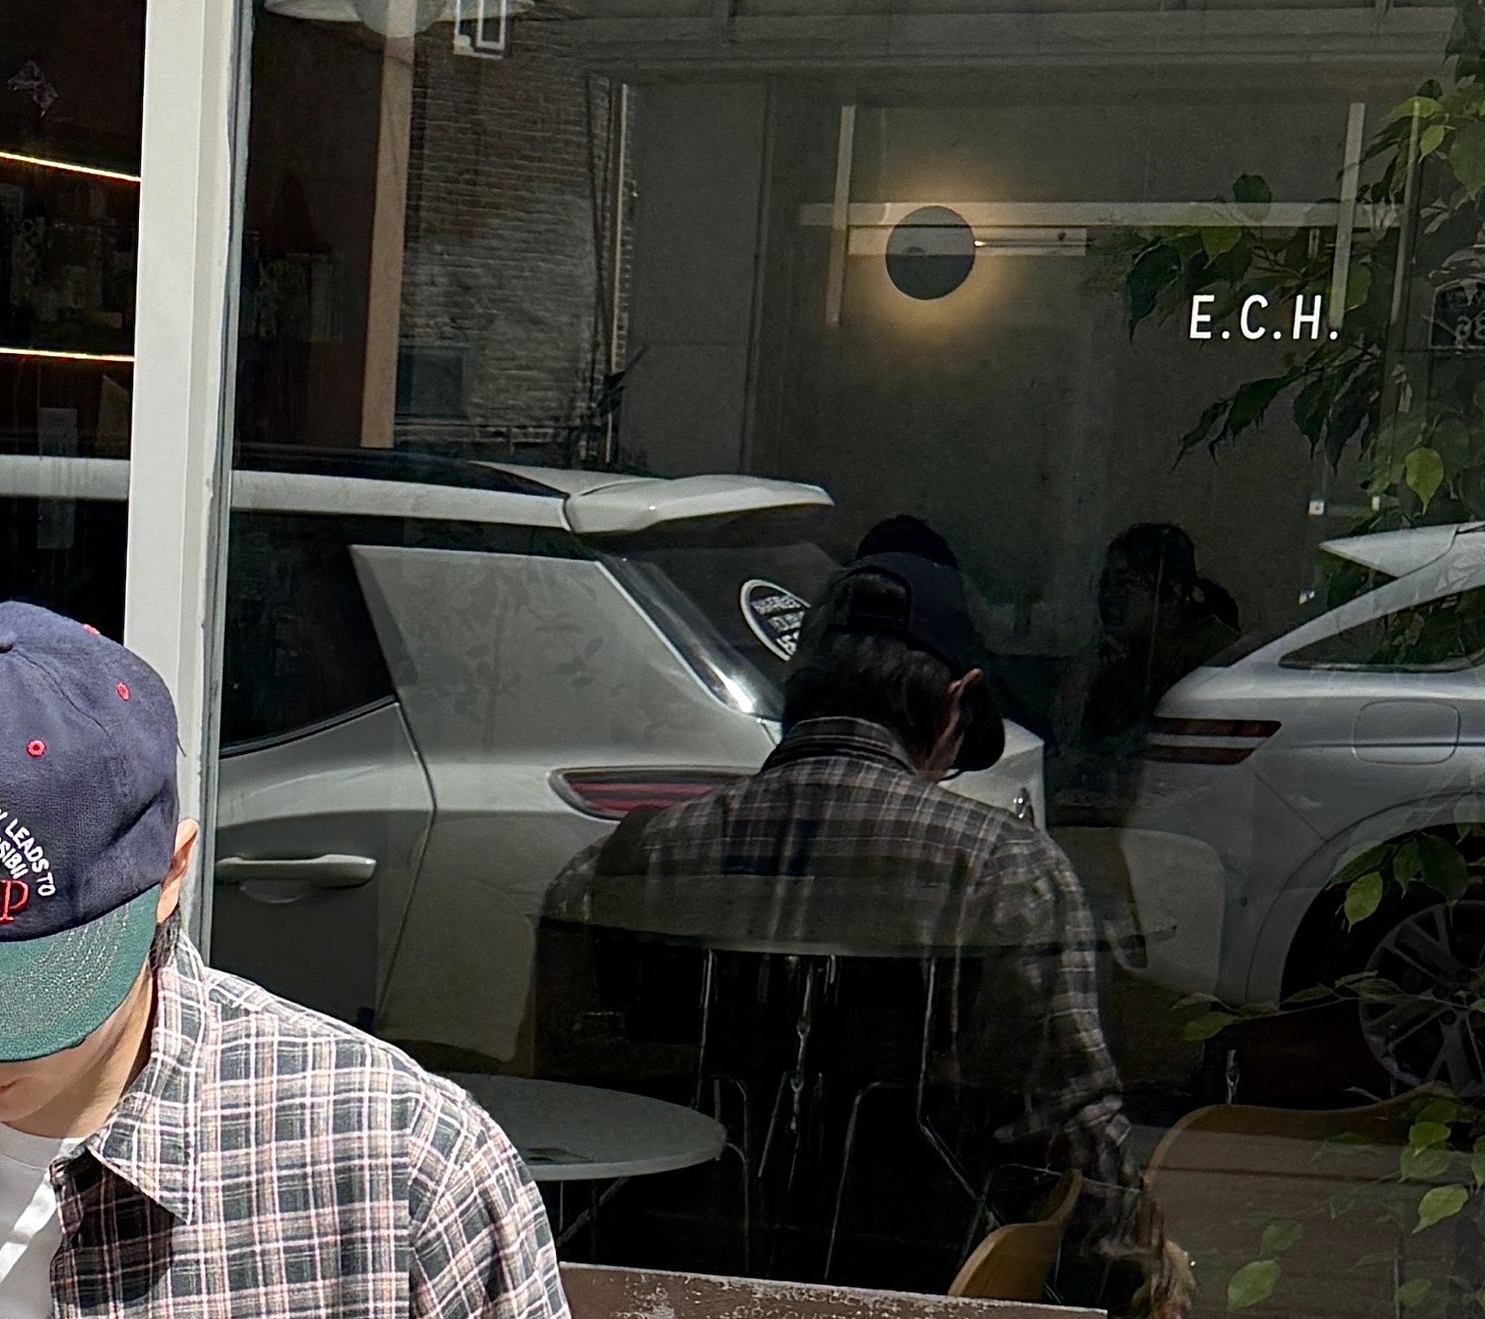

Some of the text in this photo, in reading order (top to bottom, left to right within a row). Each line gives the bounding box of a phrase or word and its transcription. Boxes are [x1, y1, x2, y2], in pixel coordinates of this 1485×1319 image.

[1189, 293, 1340, 341] E.C.H.
[4, 818, 50, 873] LEADS
[35, 871, 57, 897] TO
